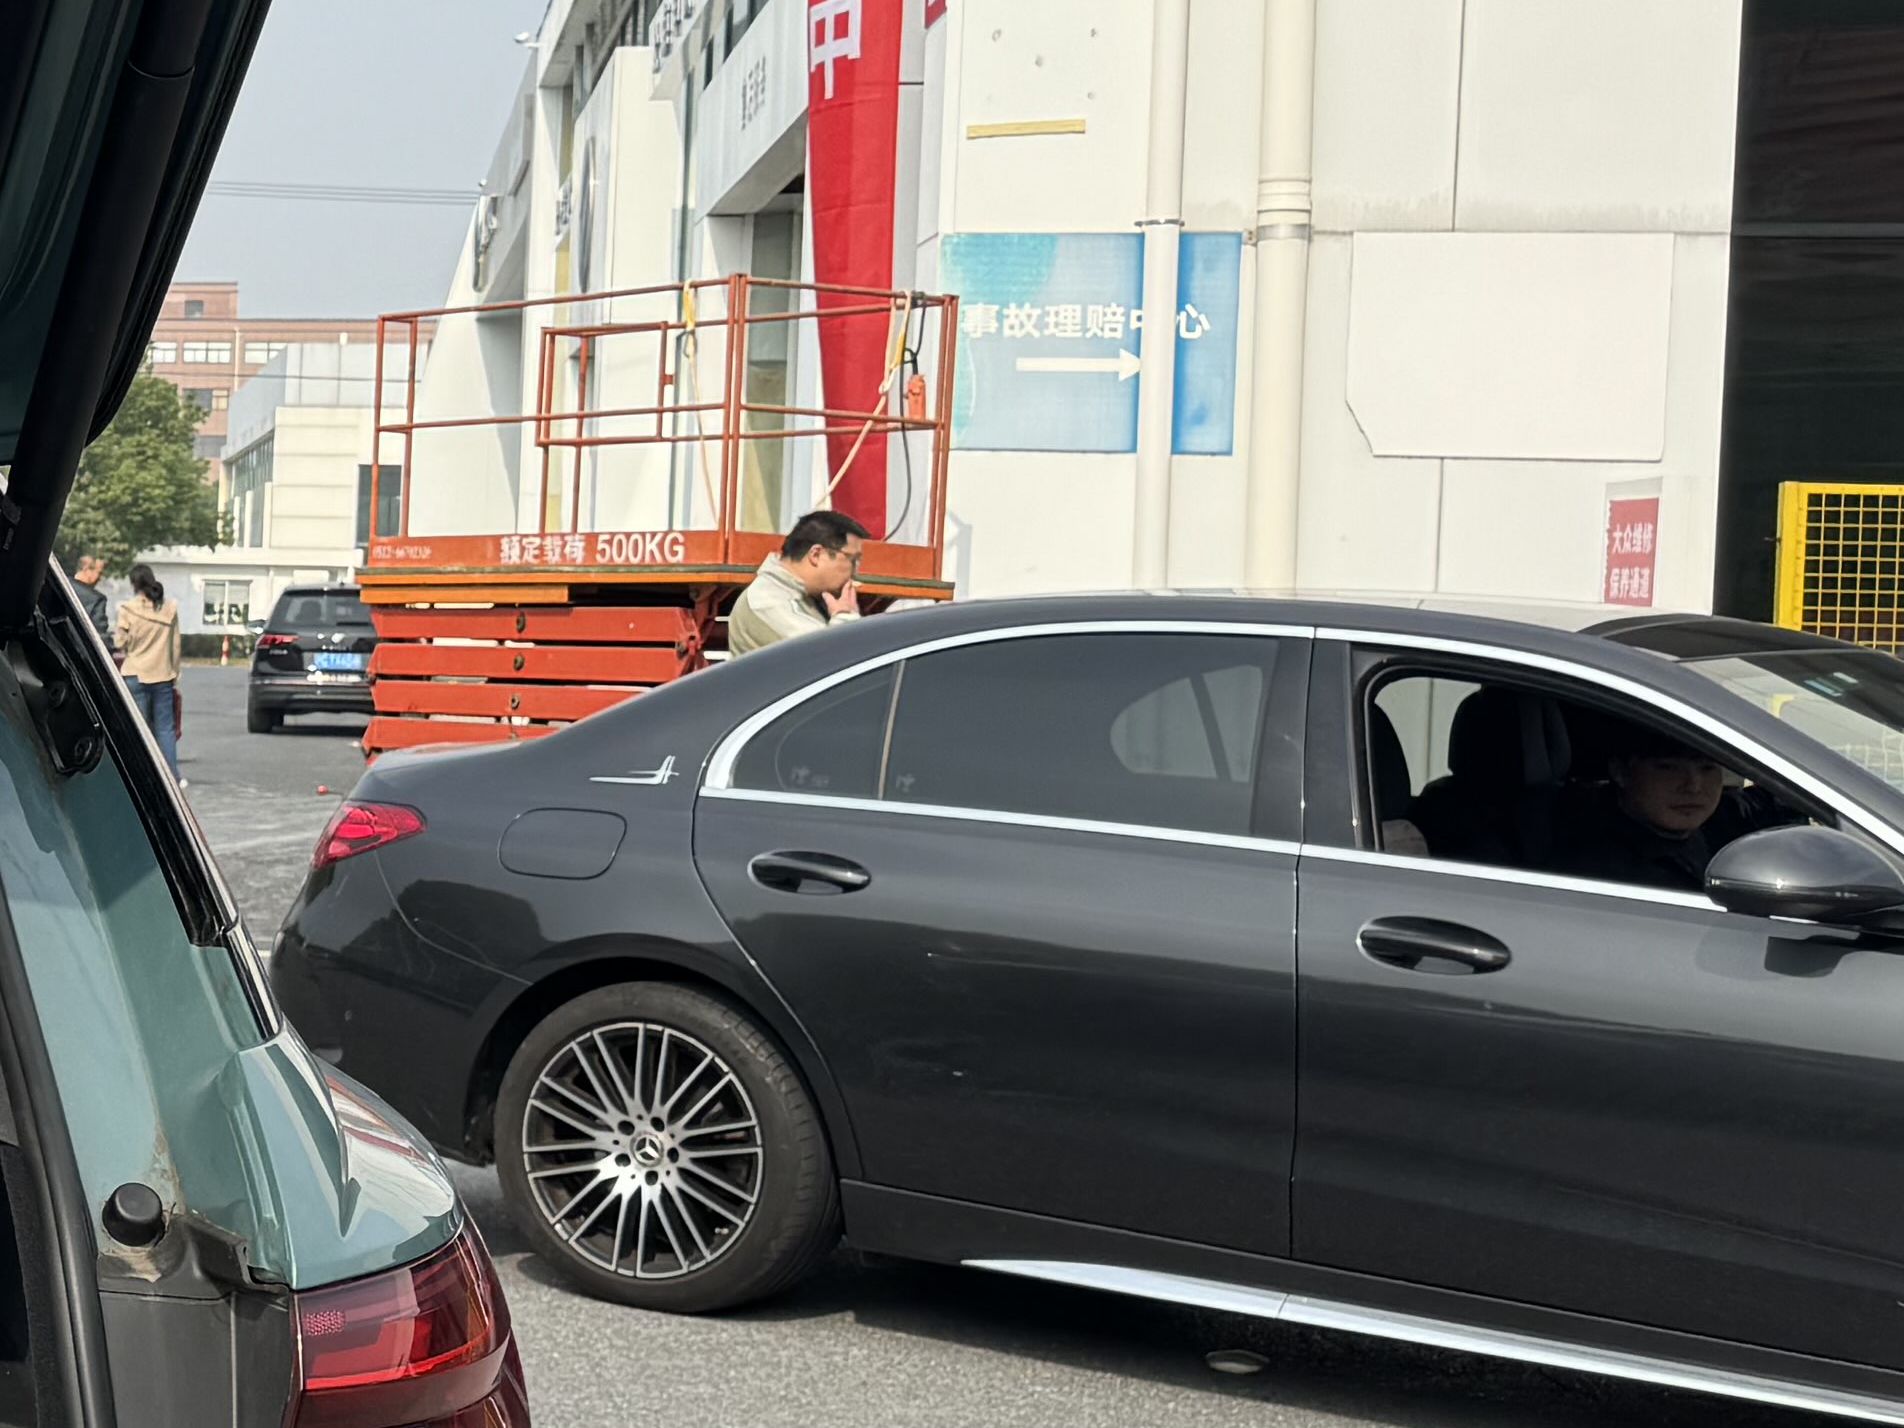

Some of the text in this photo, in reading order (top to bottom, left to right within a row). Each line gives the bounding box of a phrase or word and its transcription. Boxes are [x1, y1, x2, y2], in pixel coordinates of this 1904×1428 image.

[499, 532, 686, 565] 额定载荷 500KG
[1612, 521, 1654, 555] 大众维修
